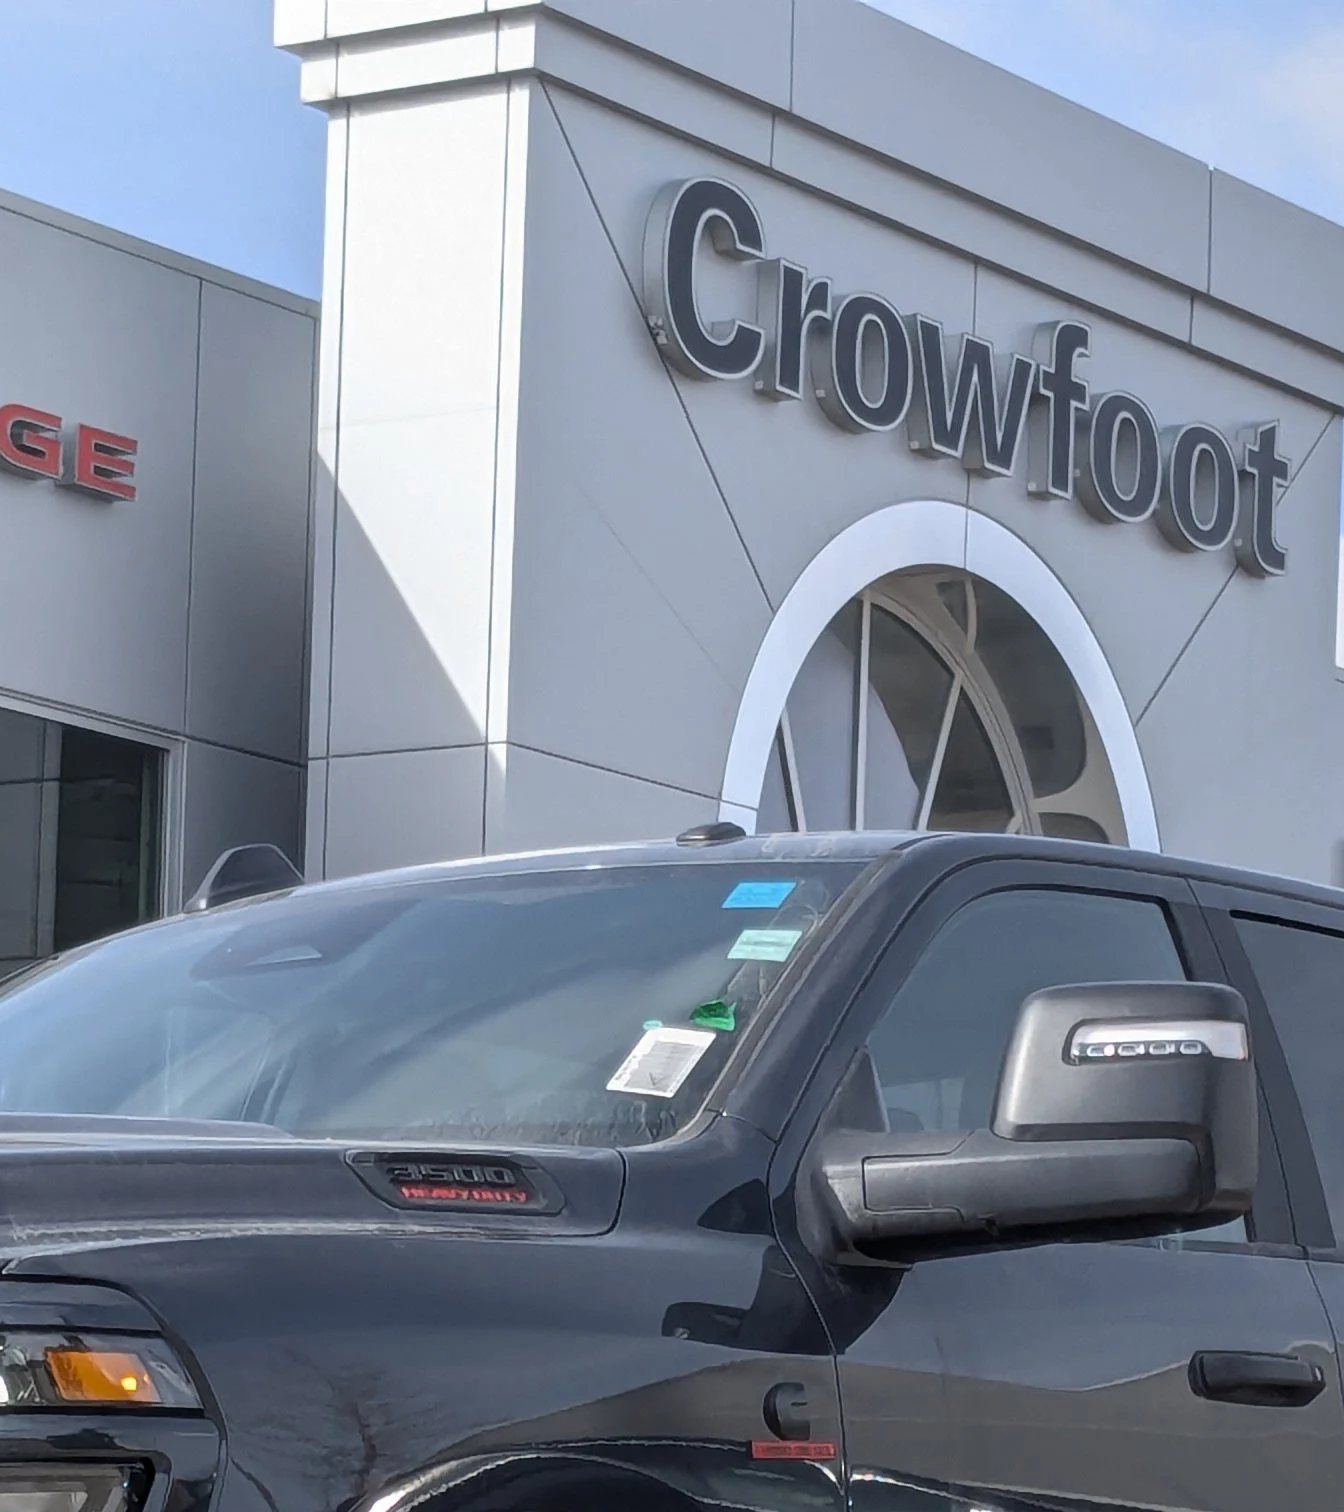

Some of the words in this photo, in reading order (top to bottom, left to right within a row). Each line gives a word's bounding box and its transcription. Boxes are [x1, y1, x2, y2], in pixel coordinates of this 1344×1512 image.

[659, 176, 1291, 576] Crowfoot
[387, 1163, 517, 1186] 3500
[401, 1186, 469, 1202] HEAVY
[470, 1189, 527, 1204] DUTY
